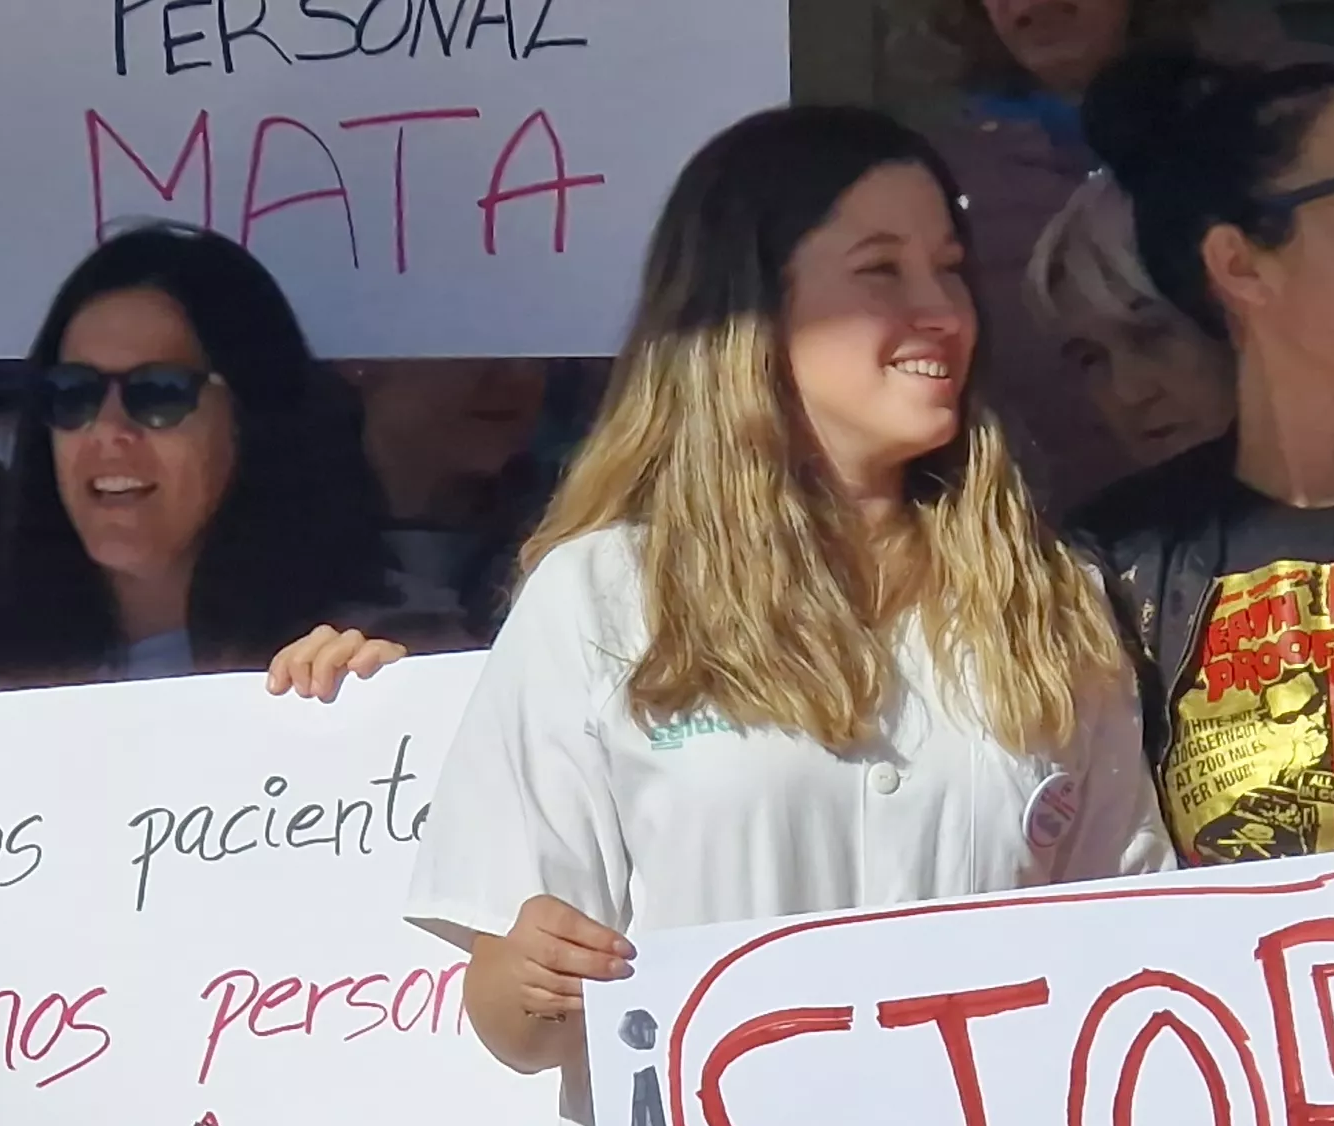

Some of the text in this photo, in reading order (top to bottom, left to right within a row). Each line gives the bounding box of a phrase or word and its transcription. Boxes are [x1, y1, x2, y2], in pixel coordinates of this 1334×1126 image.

[114, 0, 588, 76] PERSONAL
[86, 108, 605, 273] MATA
[1203, 590, 1301, 662] EATH
[1176, 739, 1267, 792] AT 200 MILES
[1181, 781, 1213, 814] PER
